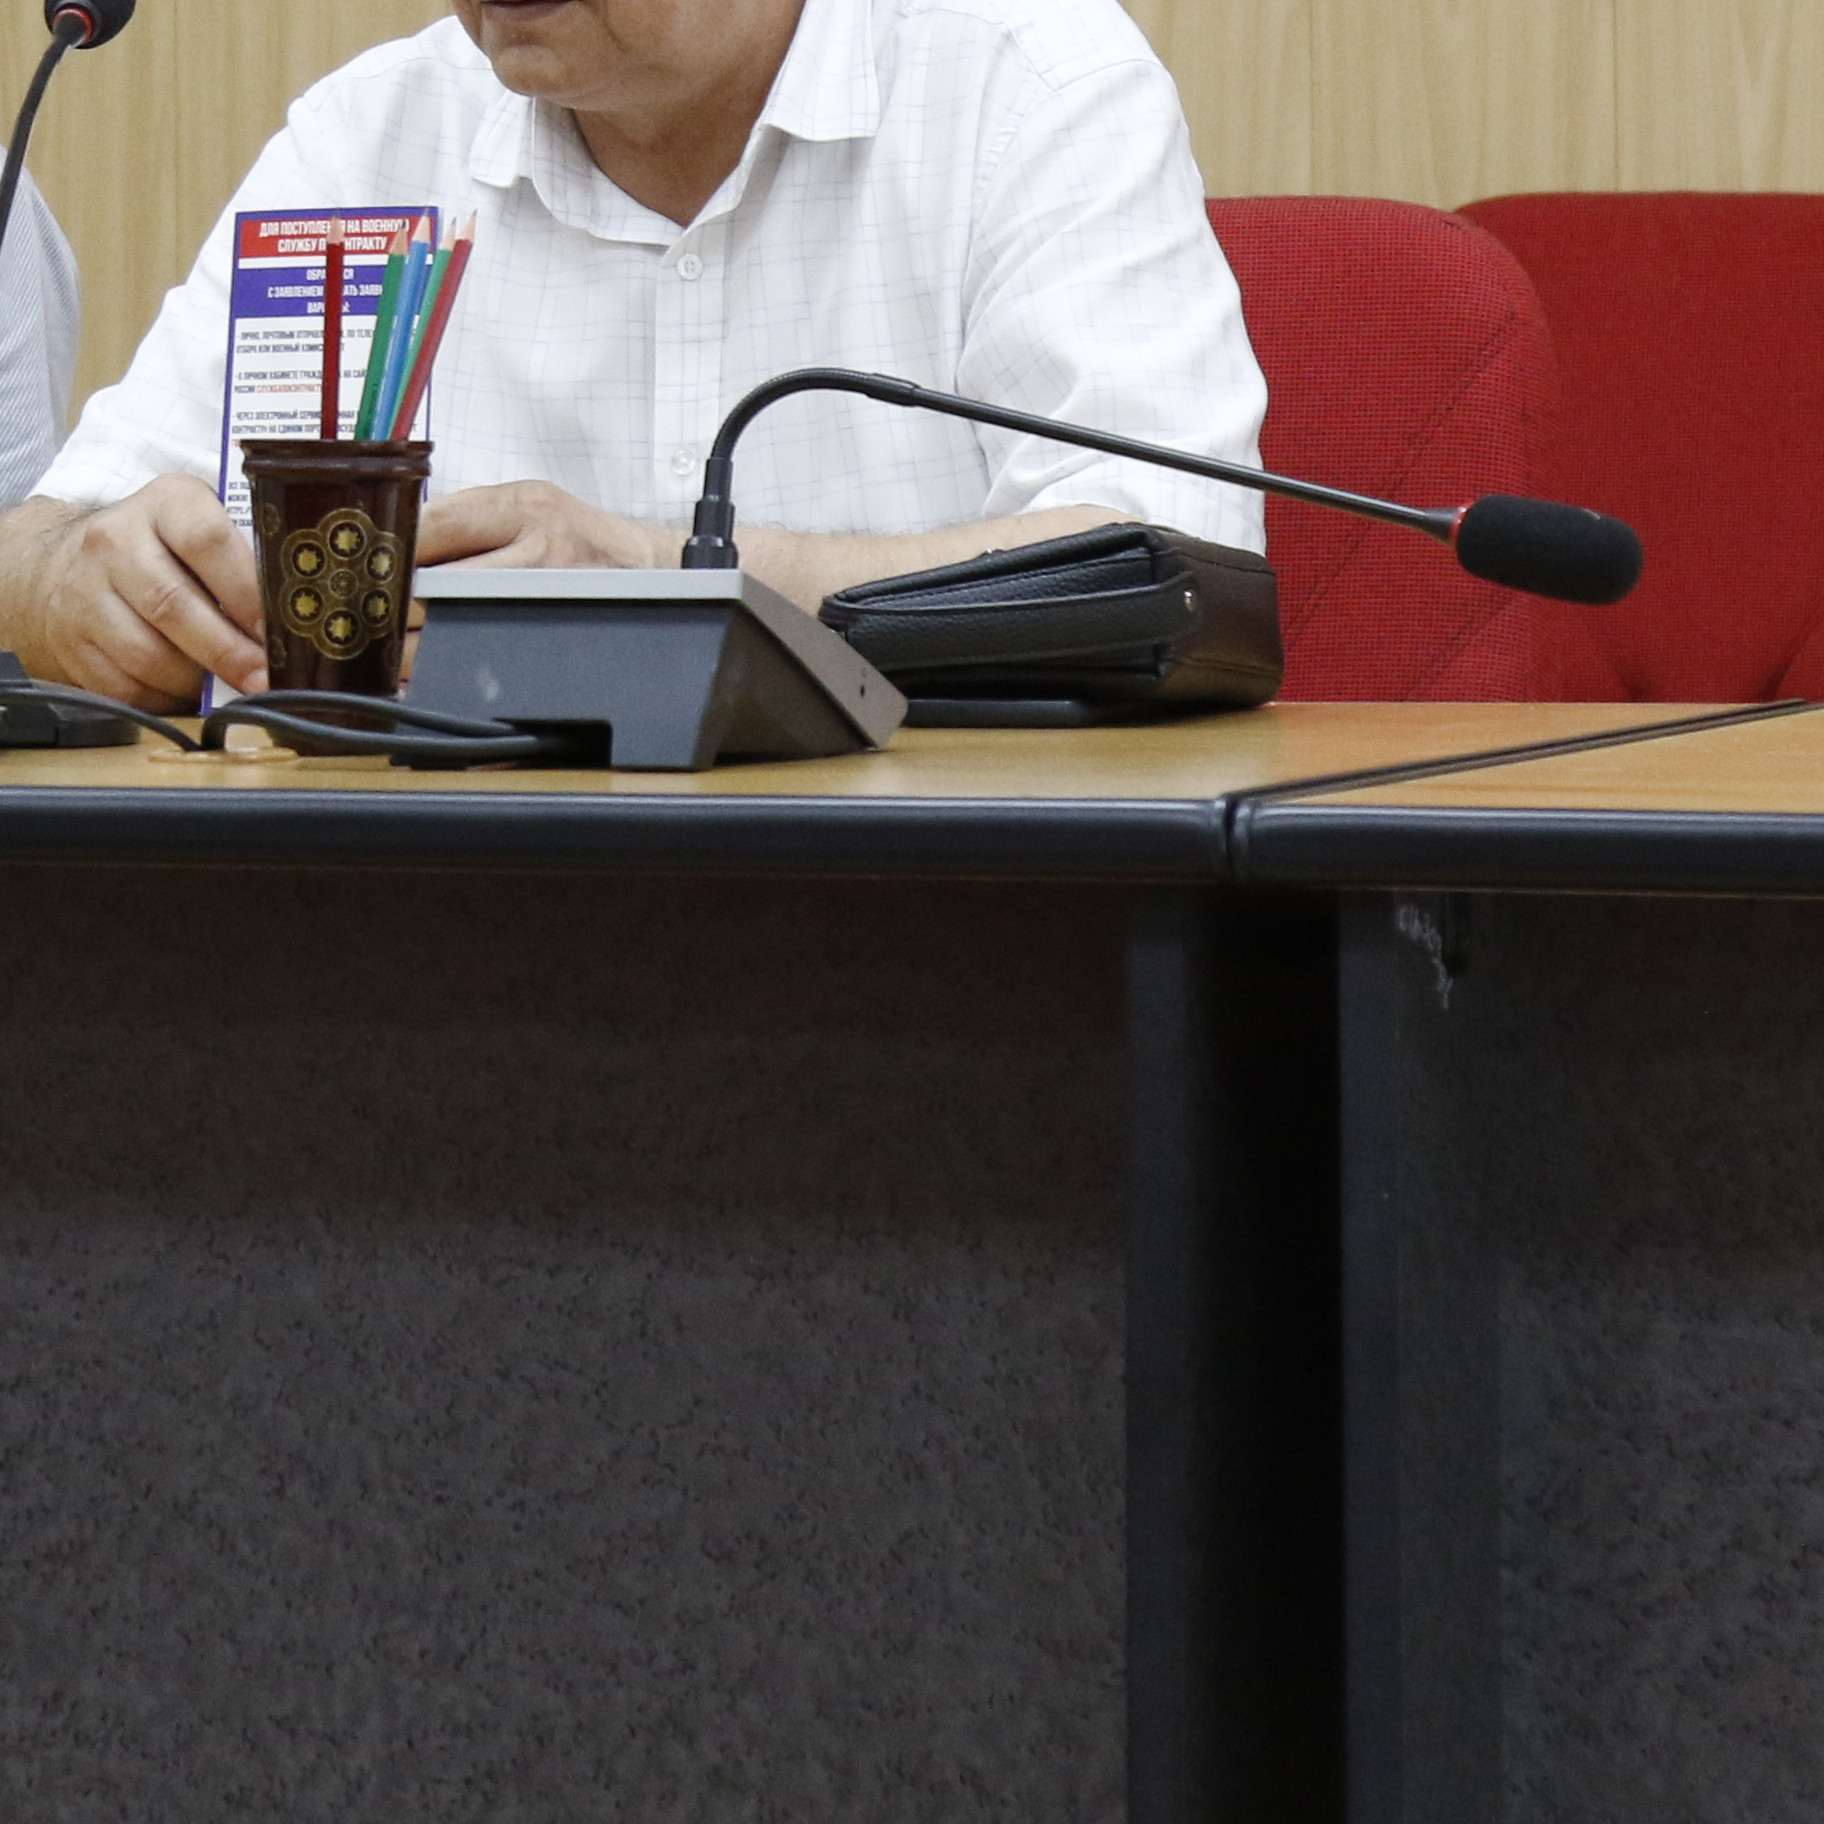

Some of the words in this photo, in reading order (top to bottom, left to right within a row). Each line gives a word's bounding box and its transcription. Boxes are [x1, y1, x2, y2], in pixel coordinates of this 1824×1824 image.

[259, 222, 280, 238] ДЛЯ
[347, 219, 361, 233] НА
[278, 237, 318, 253] СЛУЖБУ
